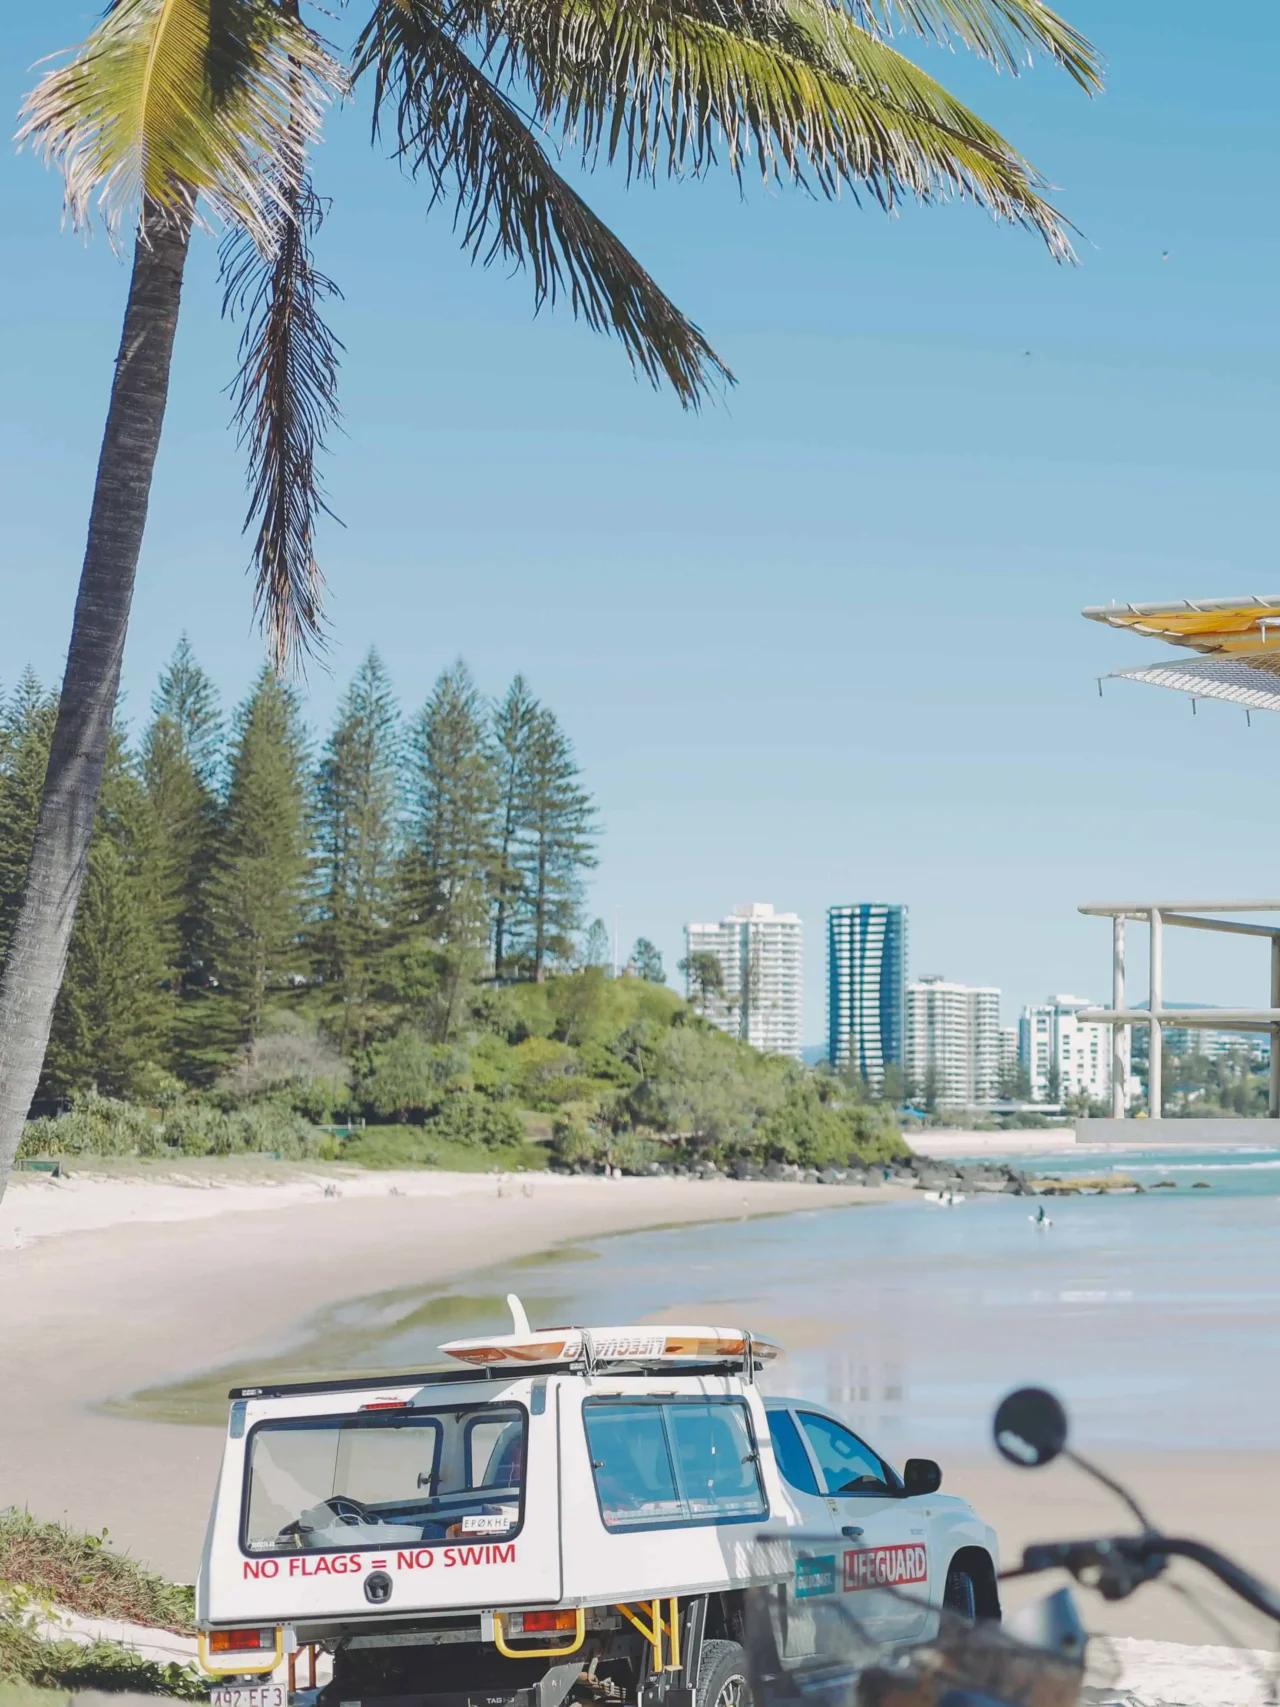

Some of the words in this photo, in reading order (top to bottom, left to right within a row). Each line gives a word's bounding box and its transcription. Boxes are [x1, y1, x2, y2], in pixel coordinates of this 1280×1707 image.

[243, 1559, 279, 1580] NO
[288, 1554, 361, 1577] FLAGS
[397, 1550, 434, 1570] NO
[444, 1544, 516, 1567] SWIM
[845, 1547, 926, 1588] LIFEGUARD
